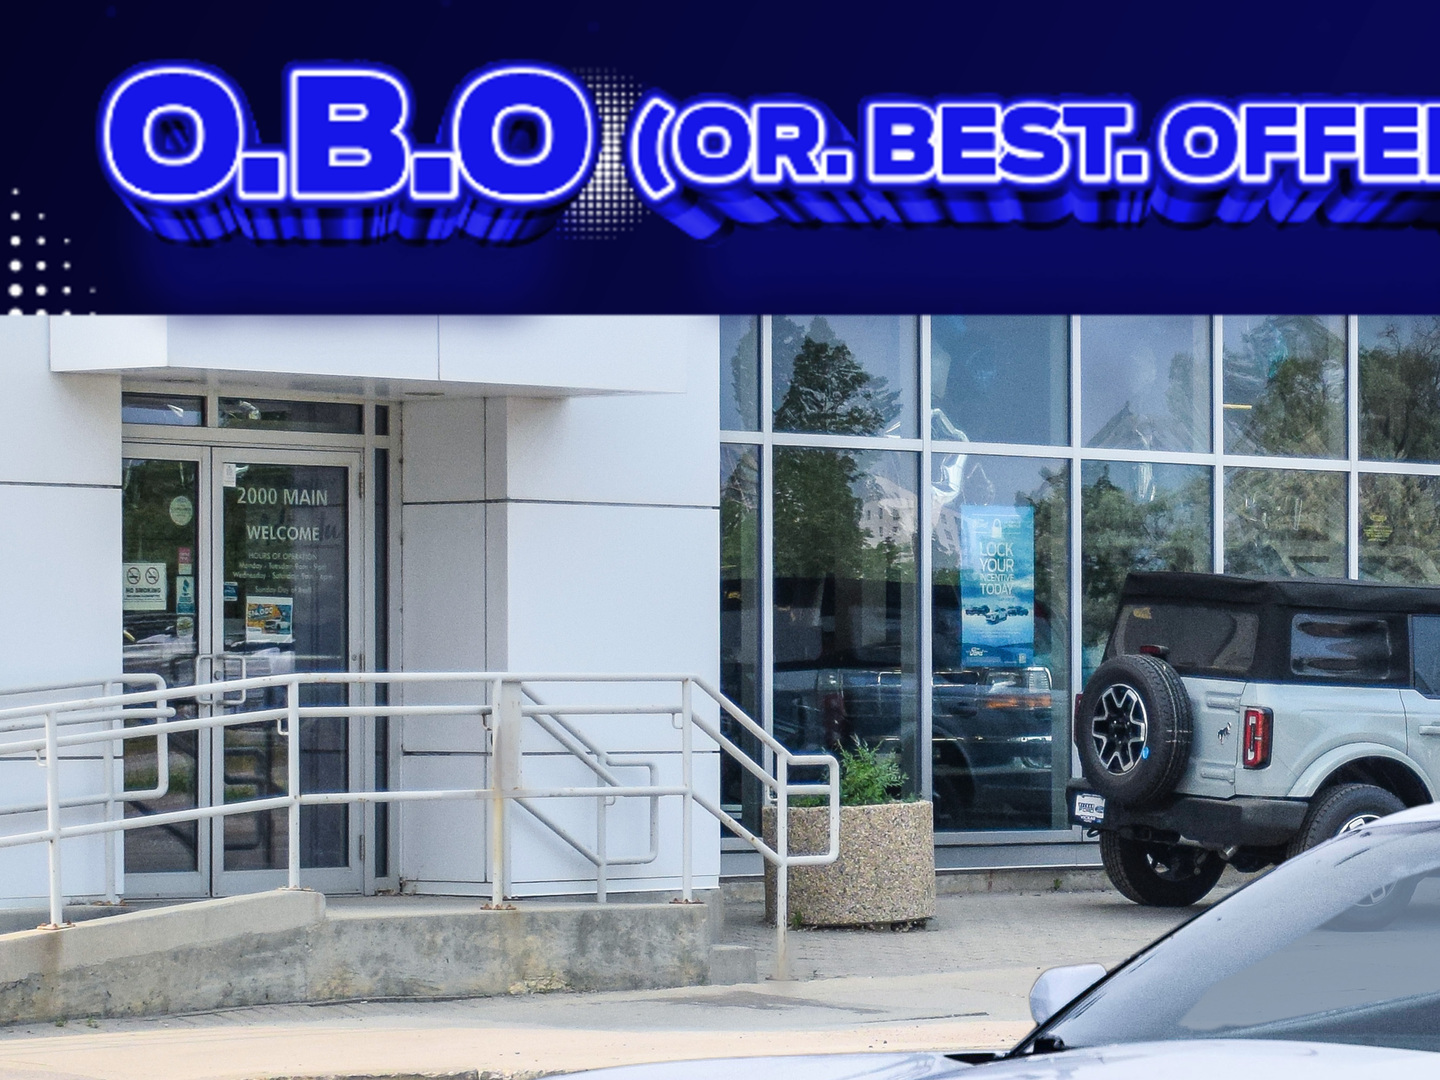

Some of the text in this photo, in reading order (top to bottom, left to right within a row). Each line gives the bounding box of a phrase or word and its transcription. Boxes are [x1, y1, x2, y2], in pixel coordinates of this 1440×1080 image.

[237, 487, 328, 506] 2000 MAIN
[246, 525, 320, 541] WELCOME
[249, 552, 270, 560] HOURS
[979, 541, 1014, 557] LOCK
[979, 558, 1014, 573] YOUR
[979, 583, 1014, 595] TODAY
